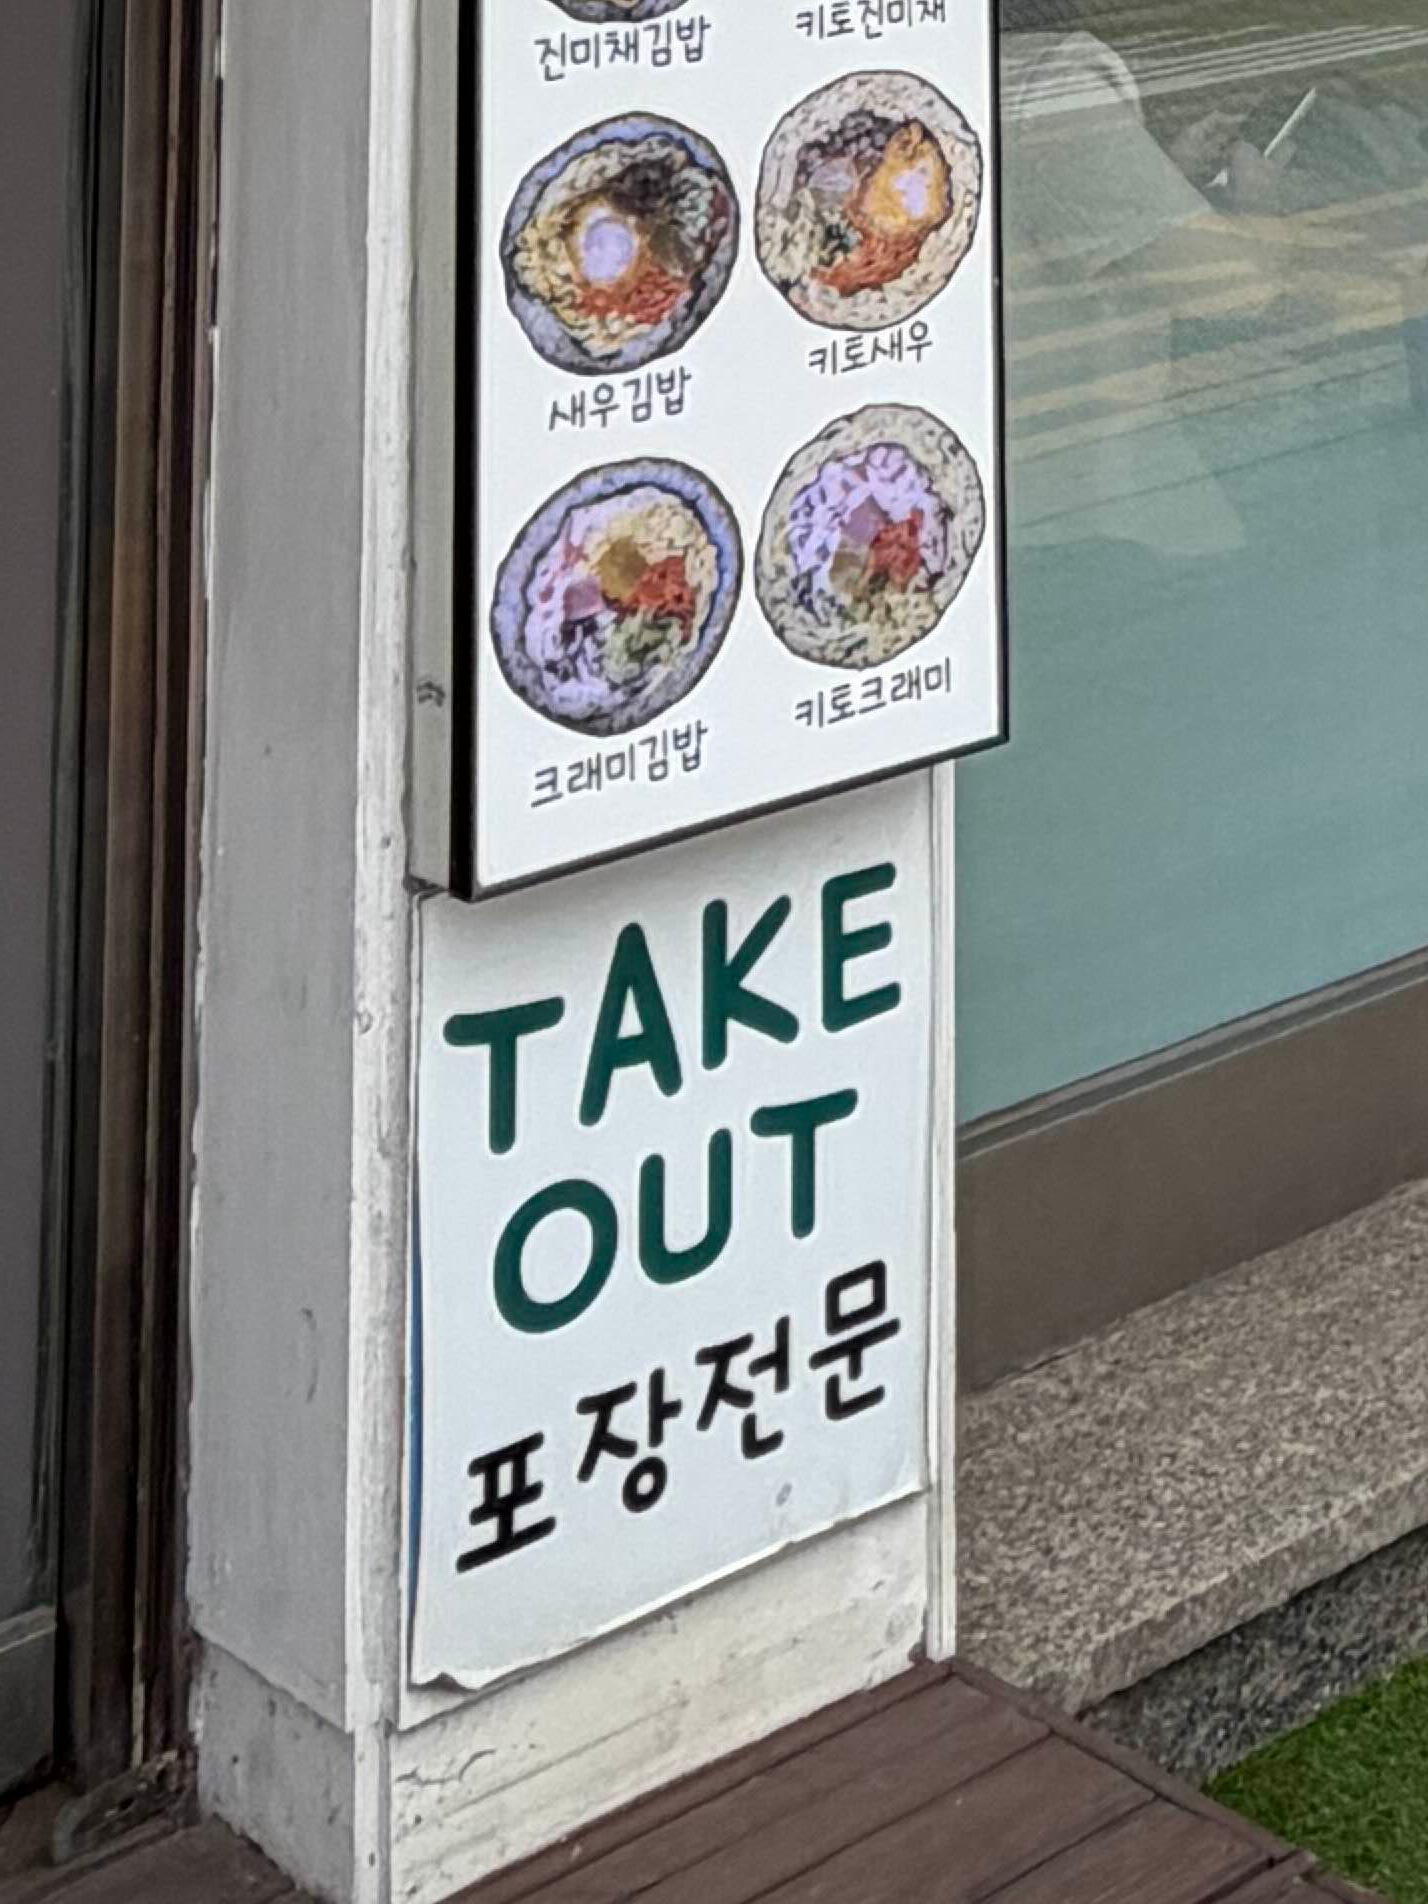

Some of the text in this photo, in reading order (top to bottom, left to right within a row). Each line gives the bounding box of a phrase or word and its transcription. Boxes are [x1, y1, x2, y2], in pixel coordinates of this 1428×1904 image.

[534, 17, 711, 82] 진미채김밥
[808, 324, 932, 376] 키토새우
[548, 369, 691, 433] 새우김밥
[793, 664, 952, 731] 키토크래미
[530, 720, 707, 809] 크래미김밥
[443, 862, 901, 1154] TAKE
[493, 1088, 858, 1334] OUT
[455, 1260, 901, 1573] 포장전문
